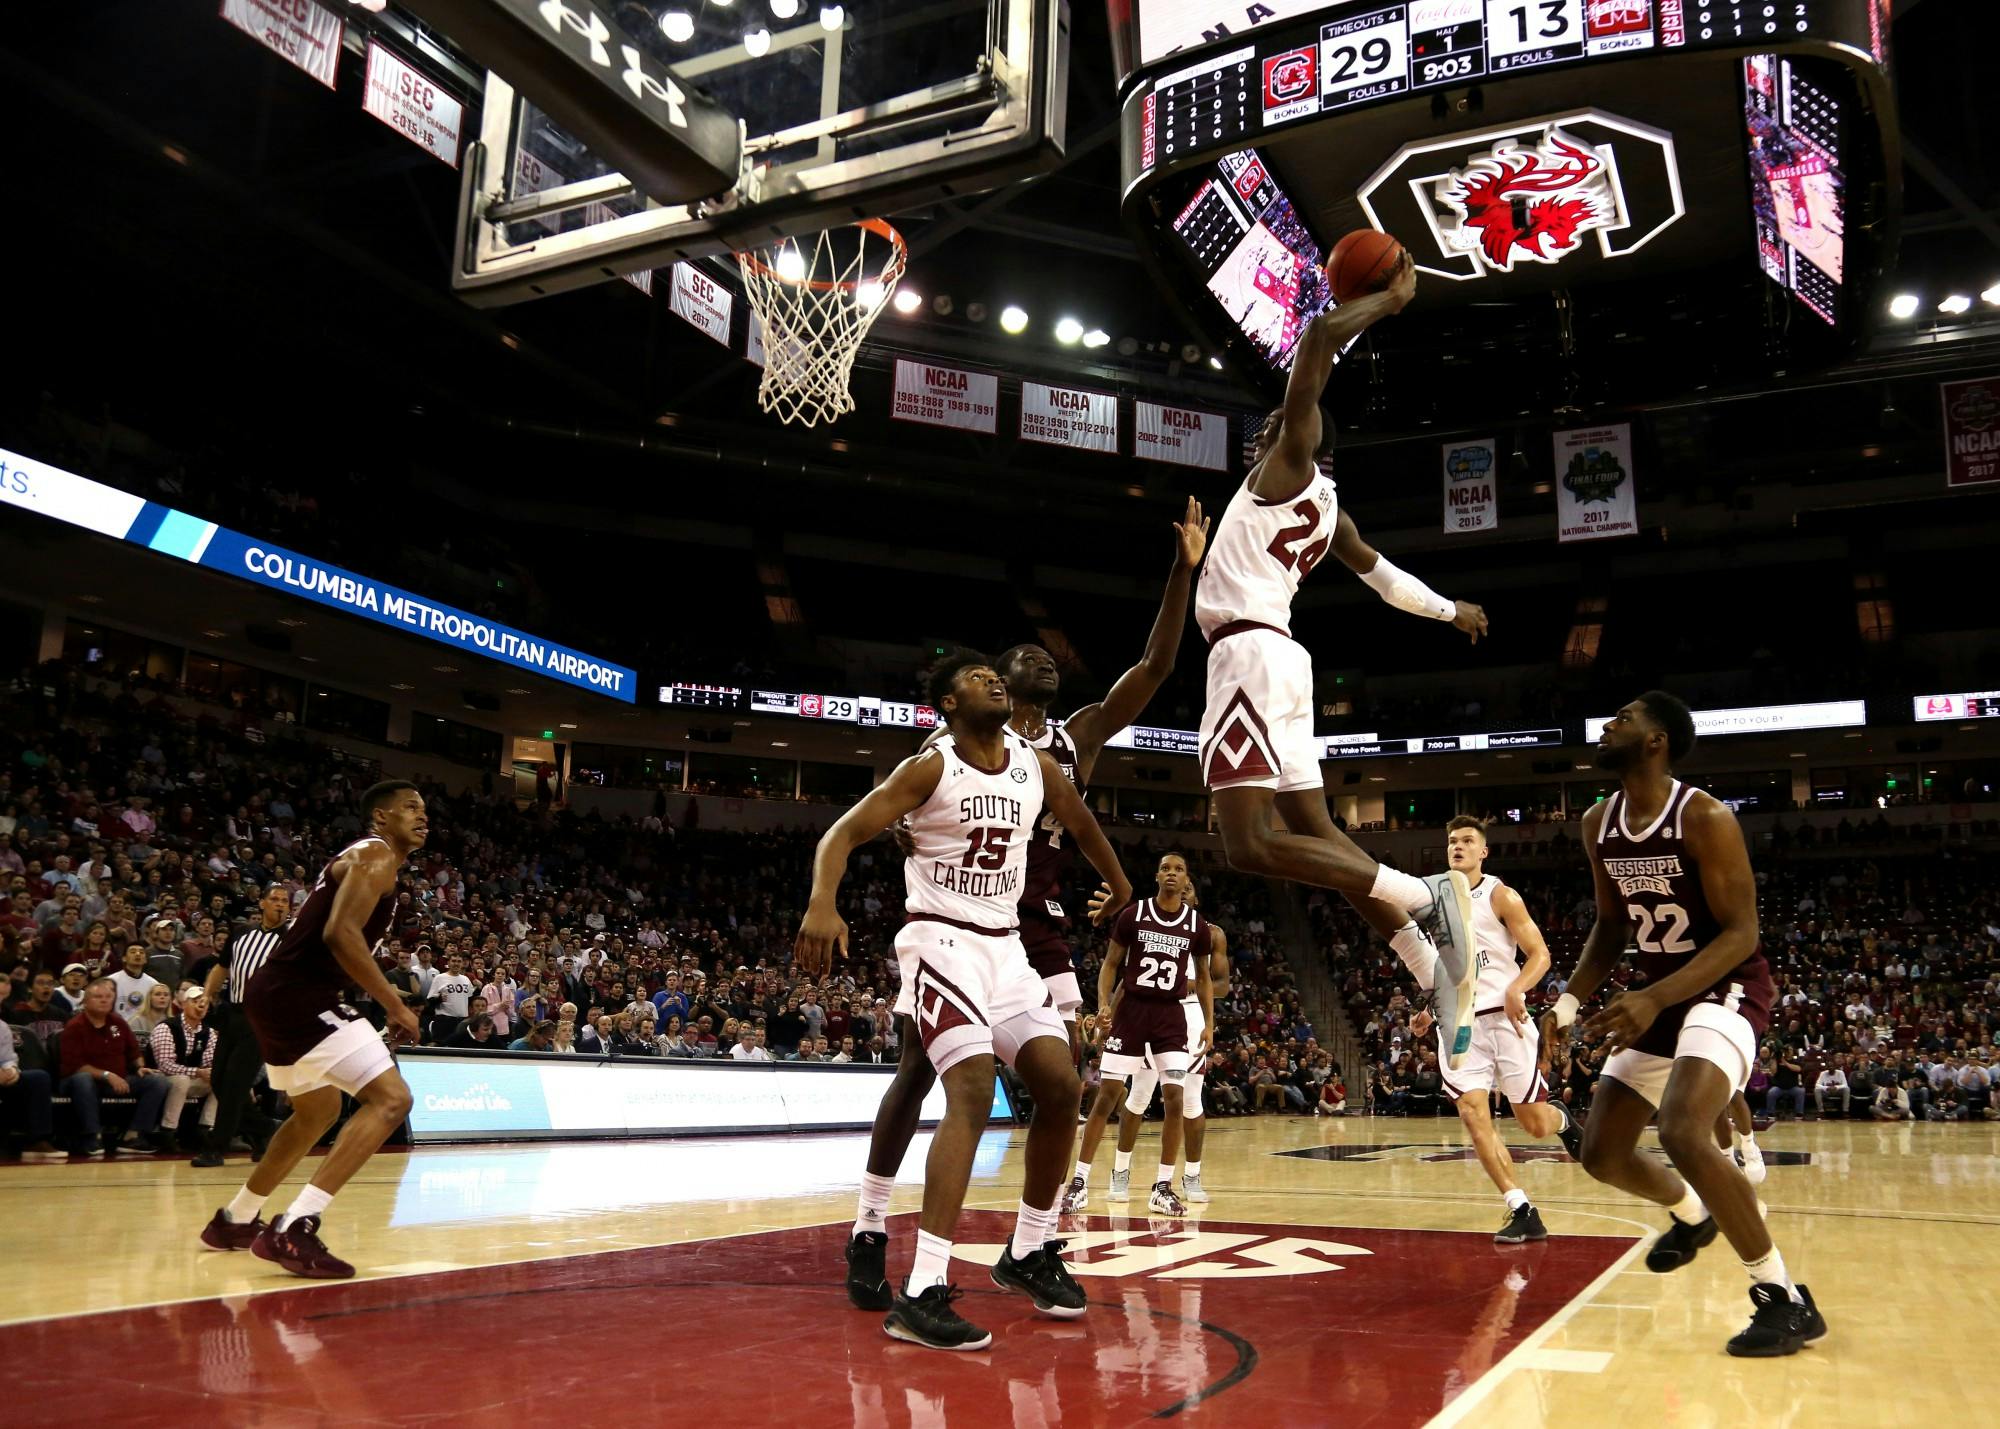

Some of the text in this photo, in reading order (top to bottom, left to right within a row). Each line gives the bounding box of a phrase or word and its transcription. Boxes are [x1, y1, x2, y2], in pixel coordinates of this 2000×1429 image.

[1660, 1, 1679, 12] 22
[1662, 4, 1806, 28] 23 0 1 0 2
[1328, 12, 1397, 38] TIMEOUTS 4
[1436, 26, 1459, 36] HALF
[1508, 0, 1569, 42] 13
[1662, 20, 1808, 44] 24 0 1 0 0
[1444, 36, 1452, 52] 1
[1600, 38, 1642, 50] BONUS
[1330, 38, 1392, 84] 29
[1424, 55, 1472, 80] 9:03
[1500, 50, 1554, 68] 8 FOULS
[401, 72, 434, 112] SEC
[1146, 98, 1153, 107] 0
[1167, 86, 1174, 96] 4
[1191, 78, 1196, 88] 1
[1214, 70, 1222, 80] 0
[1238, 62, 1246, 72] 0
[1348, 80, 1398, 101] FOULS 8
[1148, 76, 1244, 122] 5 2 1 1 1
[1144, 92, 1246, 136] 15 2 2 0 0
[1274, 104, 1309, 120] BONUS
[1144, 106, 1244, 151] 21 6 1 2 1
[1166, 144, 1174, 154] 0
[1190, 136, 1196, 146] 2
[1213, 128, 1222, 138] 0
[1240, 120, 1244, 131] 1
[692, 274, 714, 304] SEC
[692, 310, 710, 328] 2017
[925, 368, 968, 391] NCAA
[897, 391, 994, 416] 1986 1988 1989 1991
[929, 388, 964, 399] TOURNAMENT
[1050, 390, 1090, 412] NCAA
[895, 402, 944, 419] 2003 2013
[1162, 408, 1202, 432] NCAA
[1023, 424, 1070, 440] 2016 2019
[1024, 412, 1115, 436] 1982 1990 2012 2014
[1138, 432, 1181, 447] 2002 2018
[1954, 430, 2000, 454] NCAA
[1569, 471, 1620, 484] FINAL FOUR
[1968, 463, 1996, 477] 2017
[1448, 484, 1492, 506] NCAA
[1458, 516, 1482, 528] 2015
[1583, 510, 1610, 524] 2017
[1562, 521, 1632, 536] NATIONAL CHAMPION
[1266, 498, 1329, 584] 24
[244, 547, 624, 692] COLUMBIA METROPOLITAN AIRPORT
[828, 700, 852, 717] 29
[888, 706, 909, 722] 13
[1734, 717, 1746, 725] TO
[1136, 729, 1152, 738] MSU
[1160, 732, 1180, 740] 19-10
[1444, 742, 1456, 750] pm
[960, 795, 1021, 826] SOUTH
[962, 826, 1014, 870] 15
[1604, 858, 1682, 876] MISSISSIPPI
[933, 861, 1018, 897] CAROLINA
[1626, 879, 1664, 893] STATE
[1628, 903, 1697, 954] 22
[1138, 932, 1190, 949] MISSISSIPPI
[1150, 944, 1174, 954] STATE
[1136, 956, 1178, 991] 23
[447, 984, 469, 994] 803
[424, 1094, 485, 1111] Colonial
